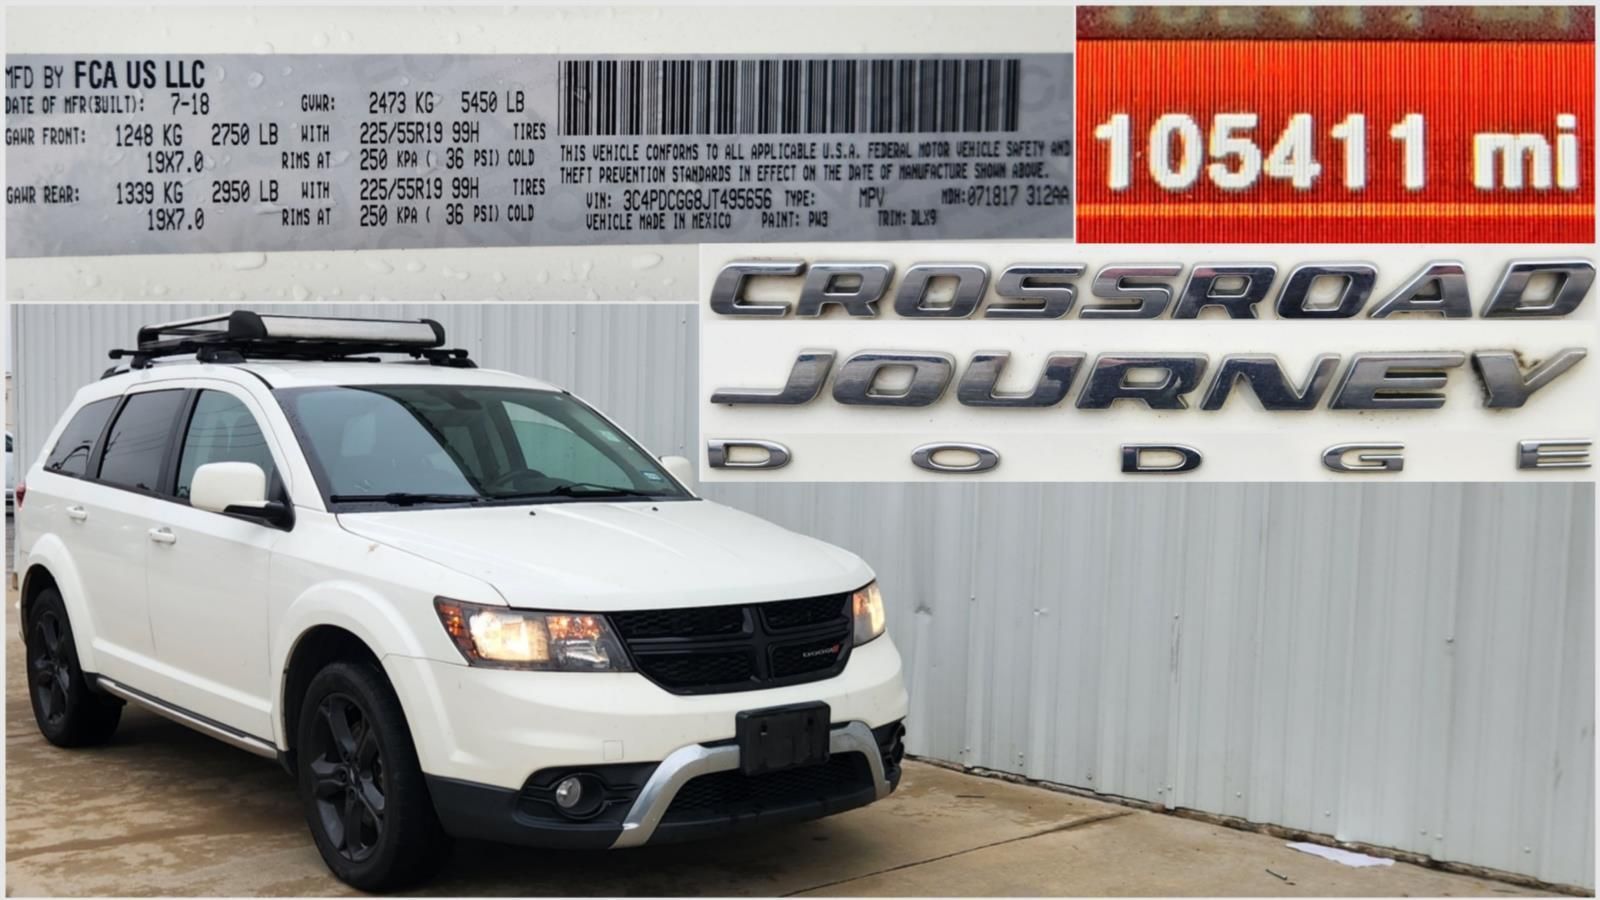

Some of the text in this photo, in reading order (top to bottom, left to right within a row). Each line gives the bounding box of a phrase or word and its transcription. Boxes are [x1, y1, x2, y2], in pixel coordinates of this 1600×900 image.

[5, 60, 205, 89] MFD BY FCA US LLC
[5, 91, 525, 115] DATE OF MFR(BUILT): 7-18 GVWR: 2473 KG 5450 LB
[5, 122, 546, 146] GAWR FRONT: 1248 KG 2750 LB WITH 225/55R19 99H TIRES
[147, 151, 203, 173] 19X7.0
[282, 152, 310, 169] RIMS
[317, 152, 331, 168] AT
[360, 149, 387, 170] 250
[397, 151, 417, 167] KPA
[446, 148, 464, 169] 36
[474, 149, 499, 167] PSI)
[508, 149, 534, 166] COLD
[560, 140, 1071, 162] THIS VEHICLE CONFORMS TO ALL APPLICABLE U.S.A. FEDERAL MOTOR VEHICLE SAFETY AND
[1095, 113, 1577, 191] 105411 mi
[560, 162, 1049, 183] THEFT PREVENTION STANDARDS IN EFFECT ON THE DATE OF MANUFACTURE SHOWN ABOVE.
[7, 178, 545, 204] GAWR REAR: 1339 KG 2950 LB WITH 225/55R19 99H TIRES
[586, 192, 612, 209] VIN:
[623, 189, 772, 211] 3C4PDCGG8JT495656
[785, 190, 815, 207] TYPE:
[860, 187, 884, 208] MPV
[148, 208, 204, 230] 19X7.0
[282, 209, 310, 226] RIMS
[317, 208, 331, 225] AT
[360, 205, 387, 226] 250
[397, 207, 417, 224] KPA
[446, 203, 464, 225] 36
[473, 205, 499, 222] PSI)
[508, 205, 534, 221] COLD
[586, 210, 937, 230] VEHICLE MADE IN MEXICO PAINT: PW3 TRIM: DLX9
[708, 258, 1595, 320] CROSSROAD
[710, 348, 1588, 411] JOURNEY
[707, 440, 1593, 473] DODGE
